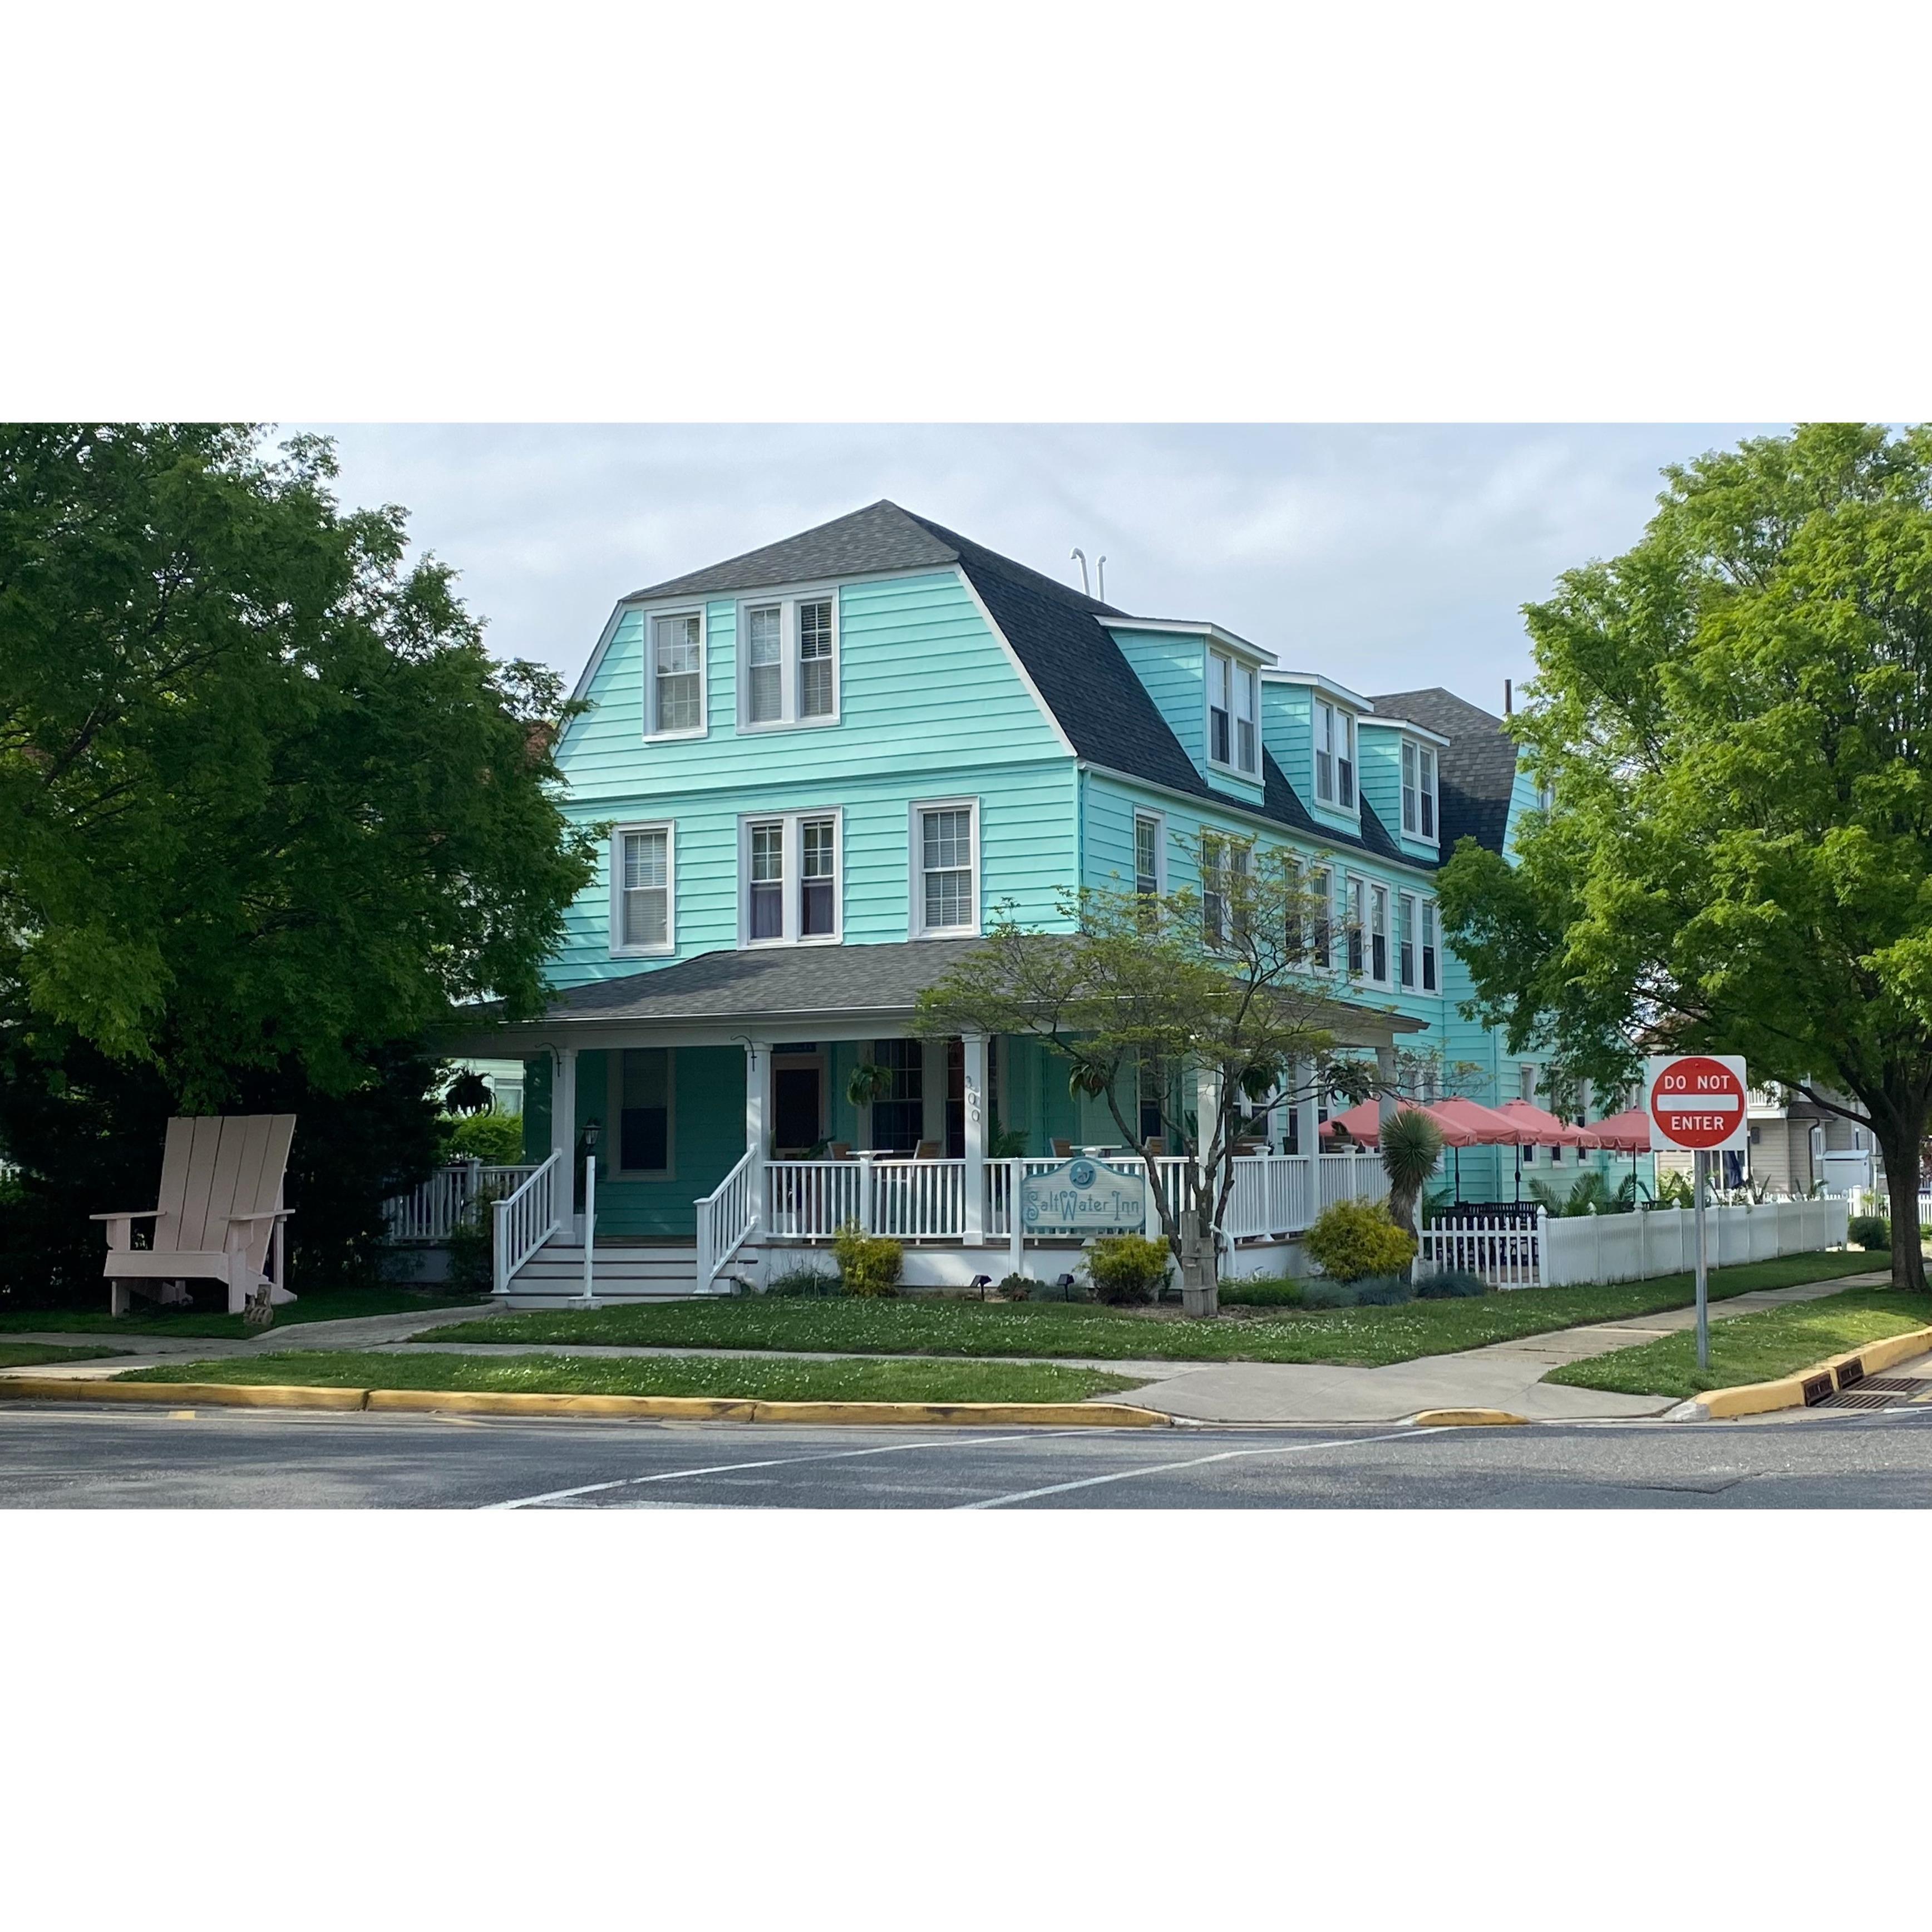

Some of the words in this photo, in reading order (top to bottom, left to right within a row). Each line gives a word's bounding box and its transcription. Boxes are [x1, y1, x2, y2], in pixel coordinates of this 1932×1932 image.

[1664, 1075, 1687, 1090] DO
[1697, 1075, 1730, 1090] NOT
[965, 1075, 979, 1122] 300
[1671, 1116, 1724, 1131] ENTER
[1111, 1190, 1139, 1221] Inn
